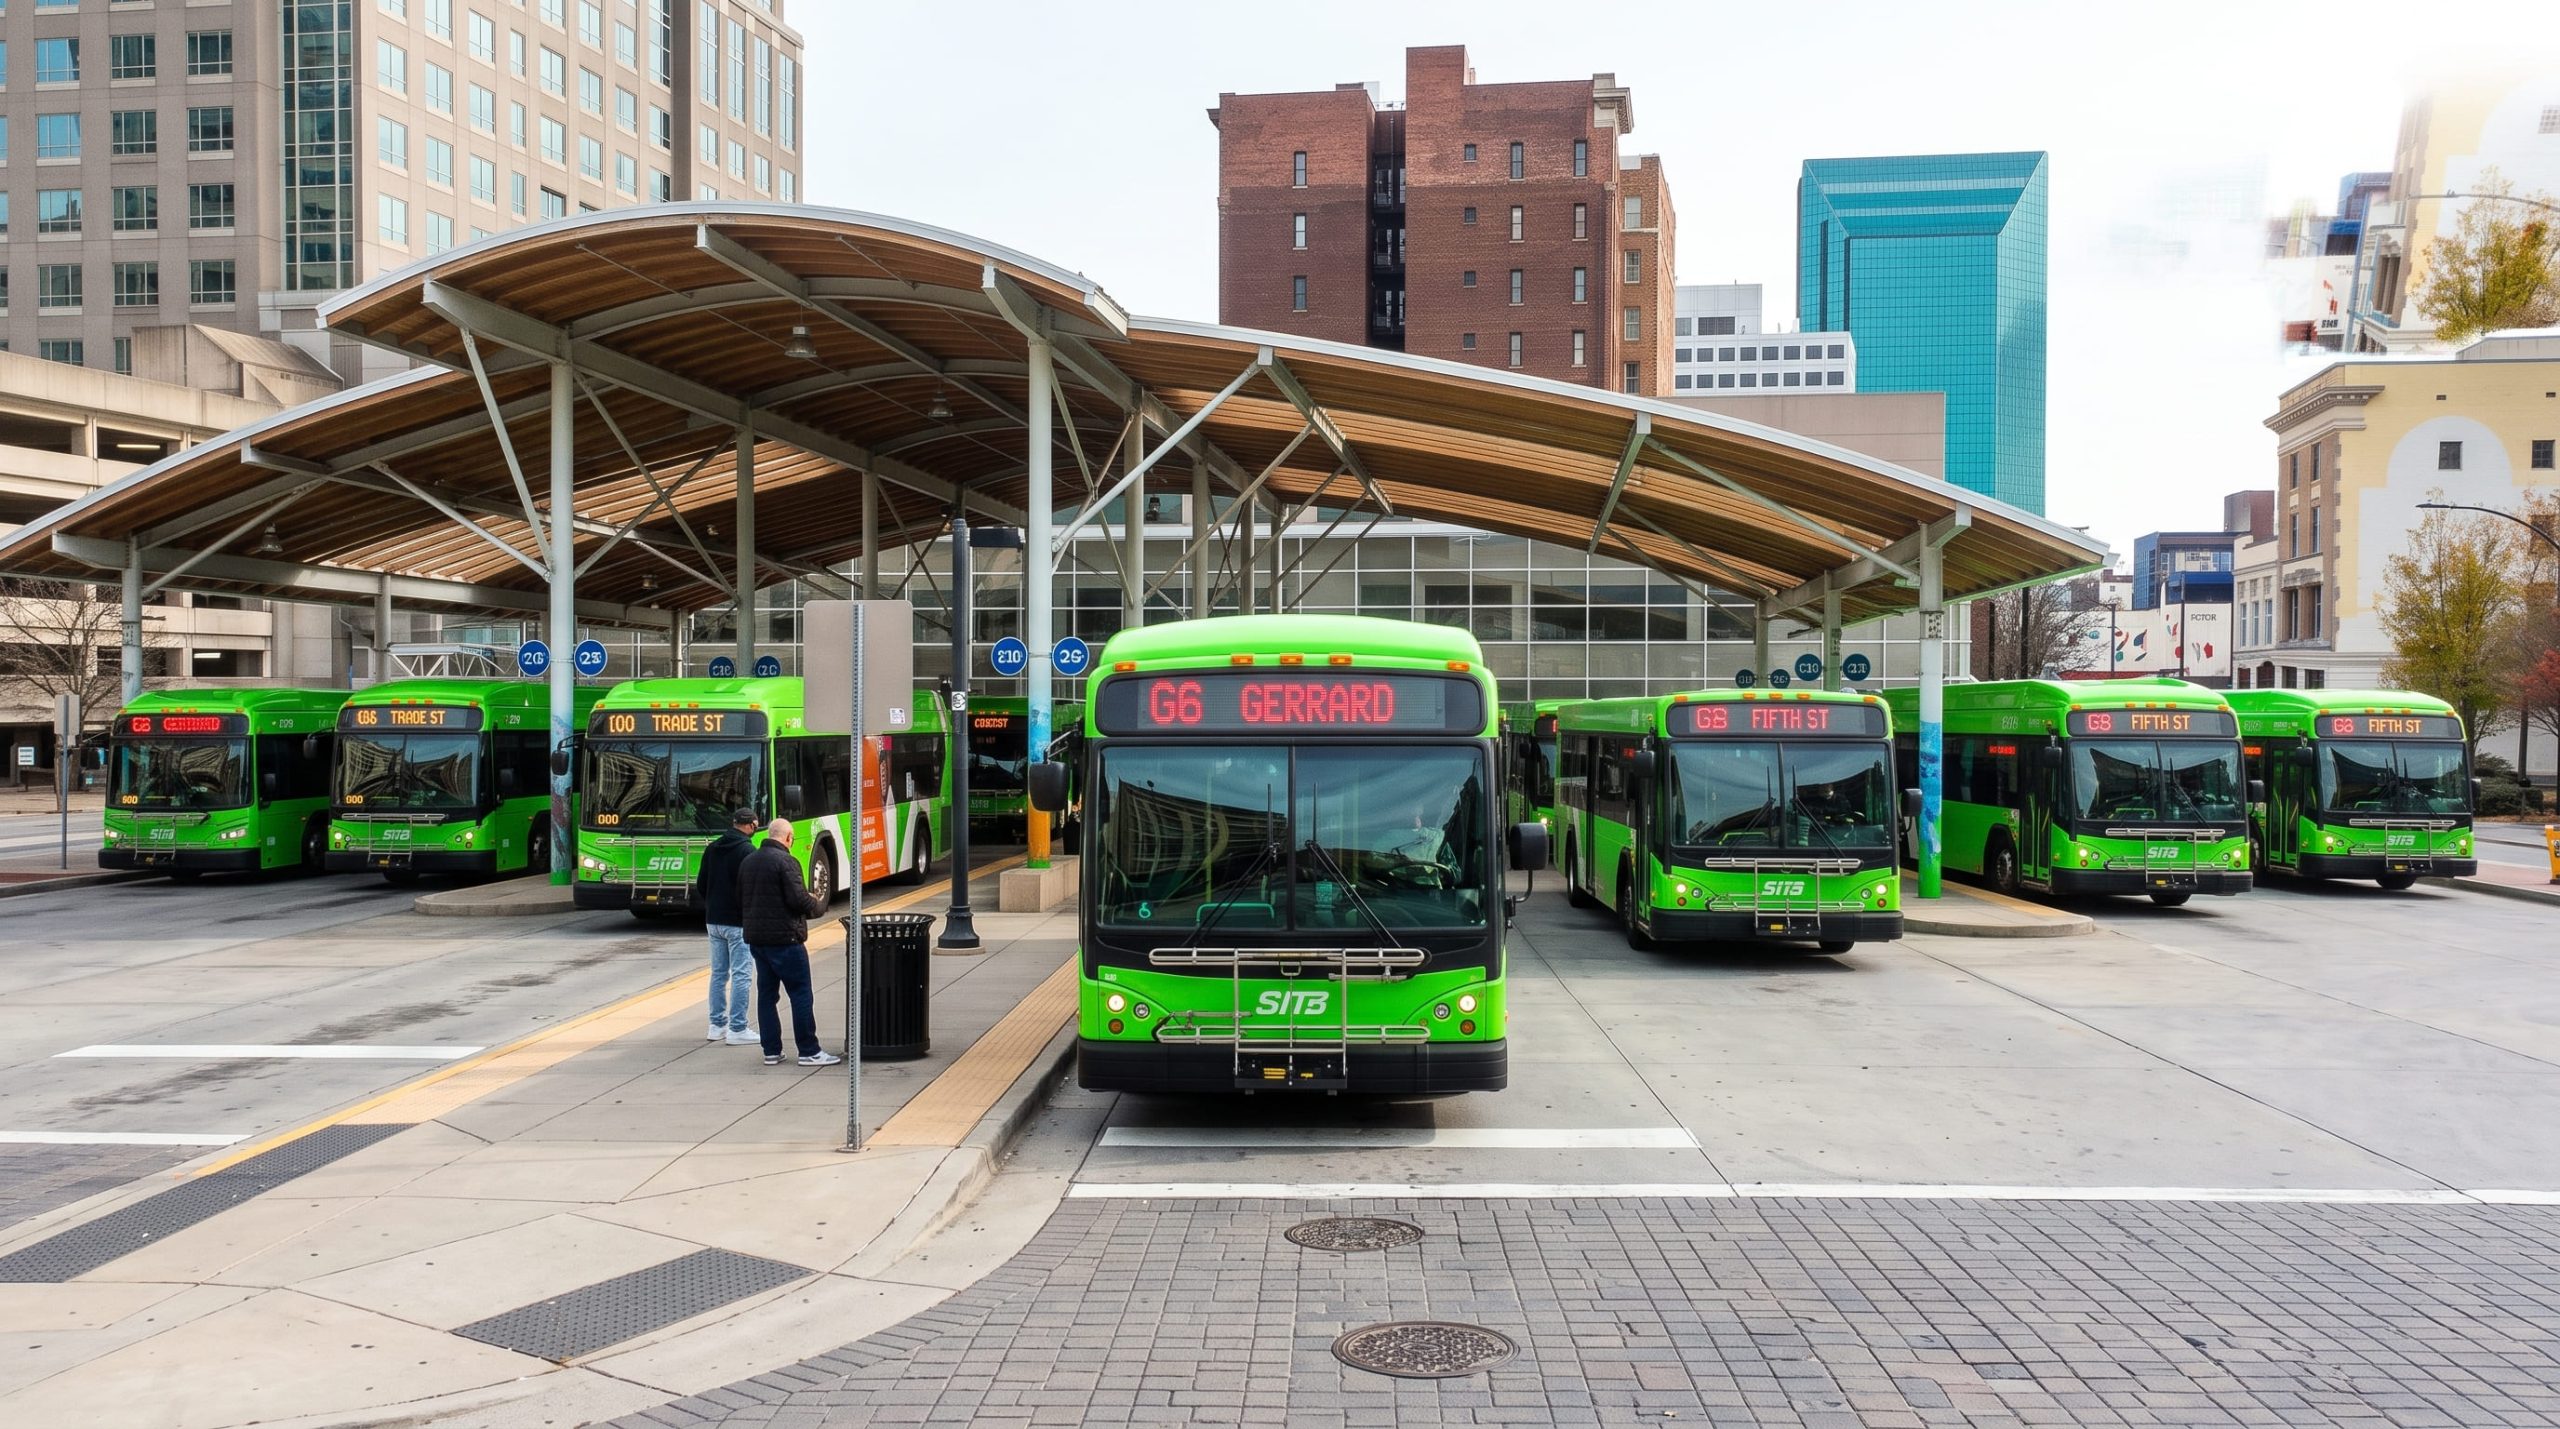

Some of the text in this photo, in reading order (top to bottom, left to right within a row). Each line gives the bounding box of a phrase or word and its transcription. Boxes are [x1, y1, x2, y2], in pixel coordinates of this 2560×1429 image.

[1151, 681, 1393, 723] G6 GERRARD
[390, 710, 427, 725] TRADE
[430, 710, 446, 725] ST
[652, 714, 699, 732] TRADE
[704, 714, 724, 732] ST
[1752, 708, 1802, 729] FIFTH
[1807, 708, 1829, 729] ST
[2131, 714, 2169, 730] FIFTH
[2173, 714, 2191, 730] ST
[2368, 718, 2402, 733] FIFTH
[2406, 719, 2422, 734] ST
